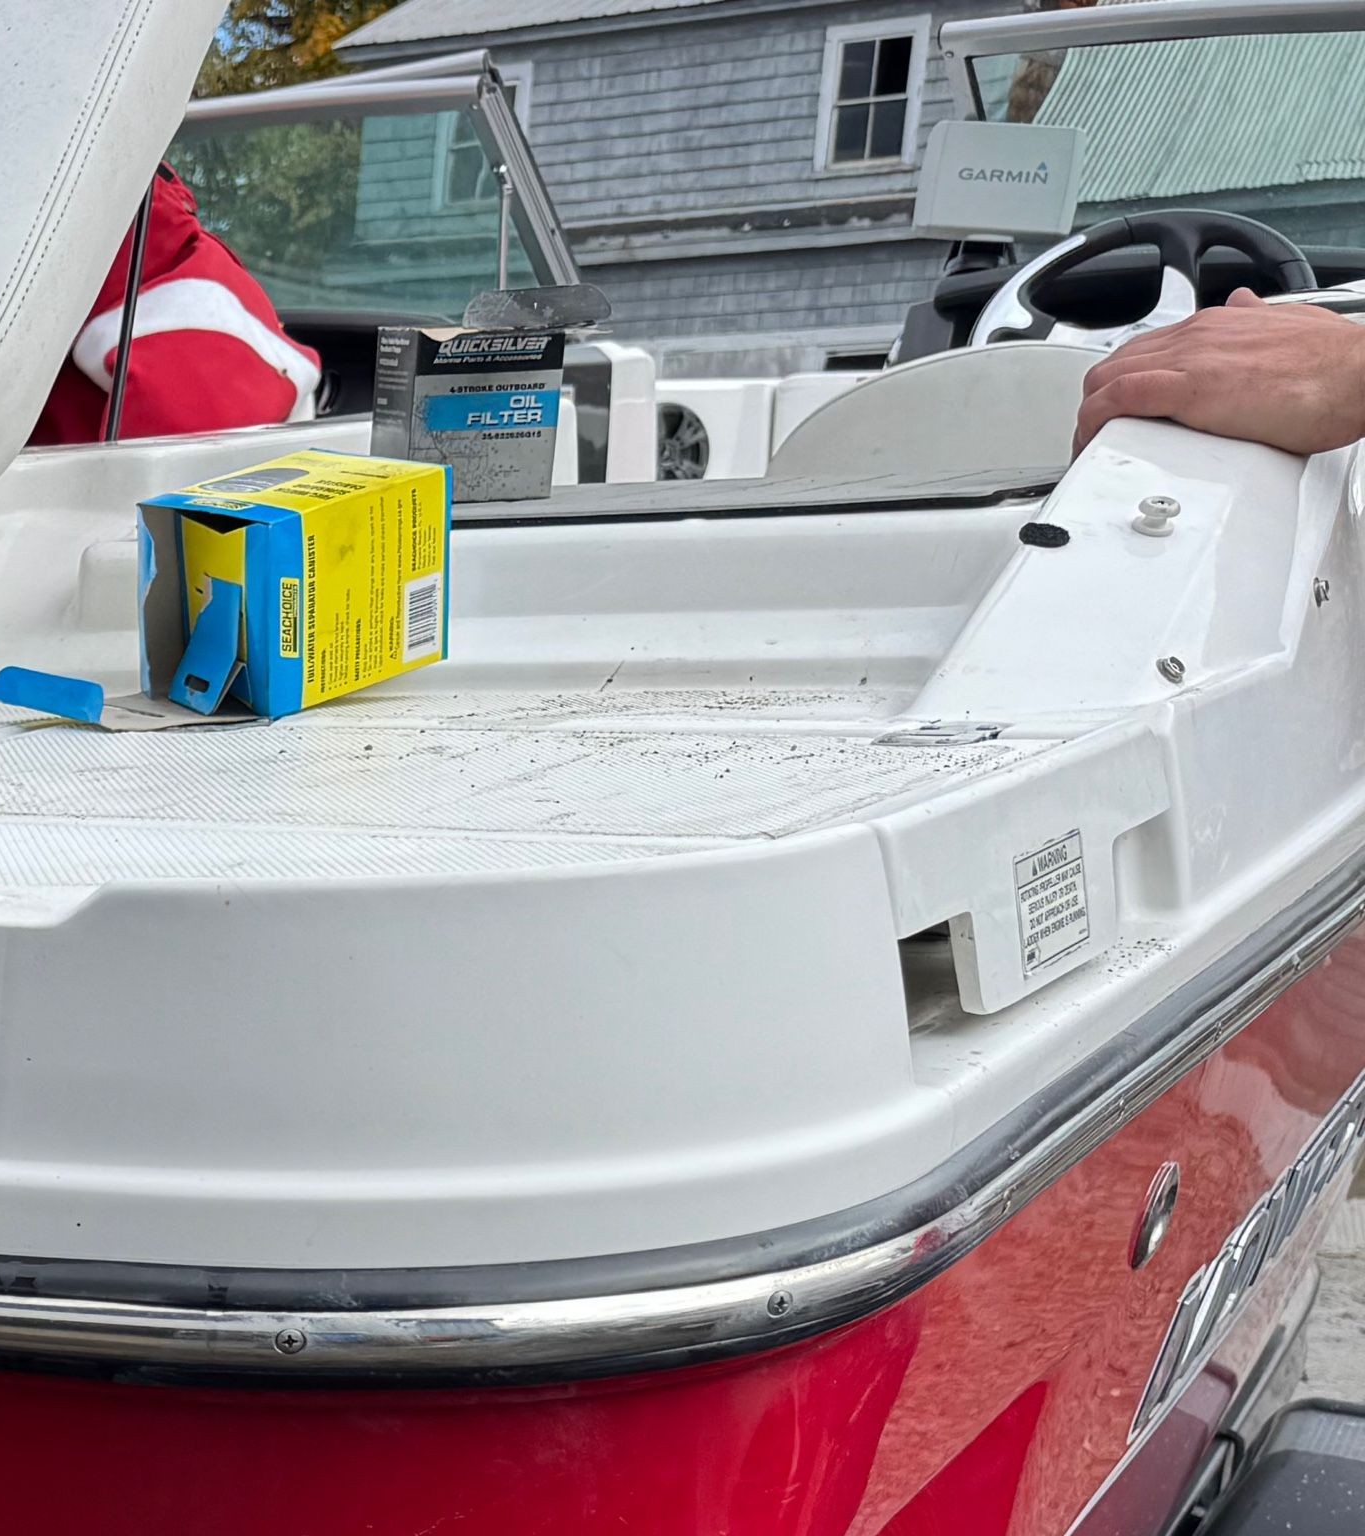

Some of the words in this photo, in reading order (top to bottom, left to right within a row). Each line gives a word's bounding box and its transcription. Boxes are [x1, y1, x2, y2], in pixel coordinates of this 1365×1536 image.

[958, 167, 1049, 185] GARMIN
[438, 337, 549, 357] QUICKSILVER
[449, 385, 494, 393] 4-STROKE
[495, 383, 545, 392] OUTBOARD
[509, 395, 544, 409] OIL
[466, 410, 543, 426] FILTER
[307, 535, 315, 578] CANISTER
[282, 582, 292, 652] SEACHOICE
[1037, 845, 1068, 873] WARNING
